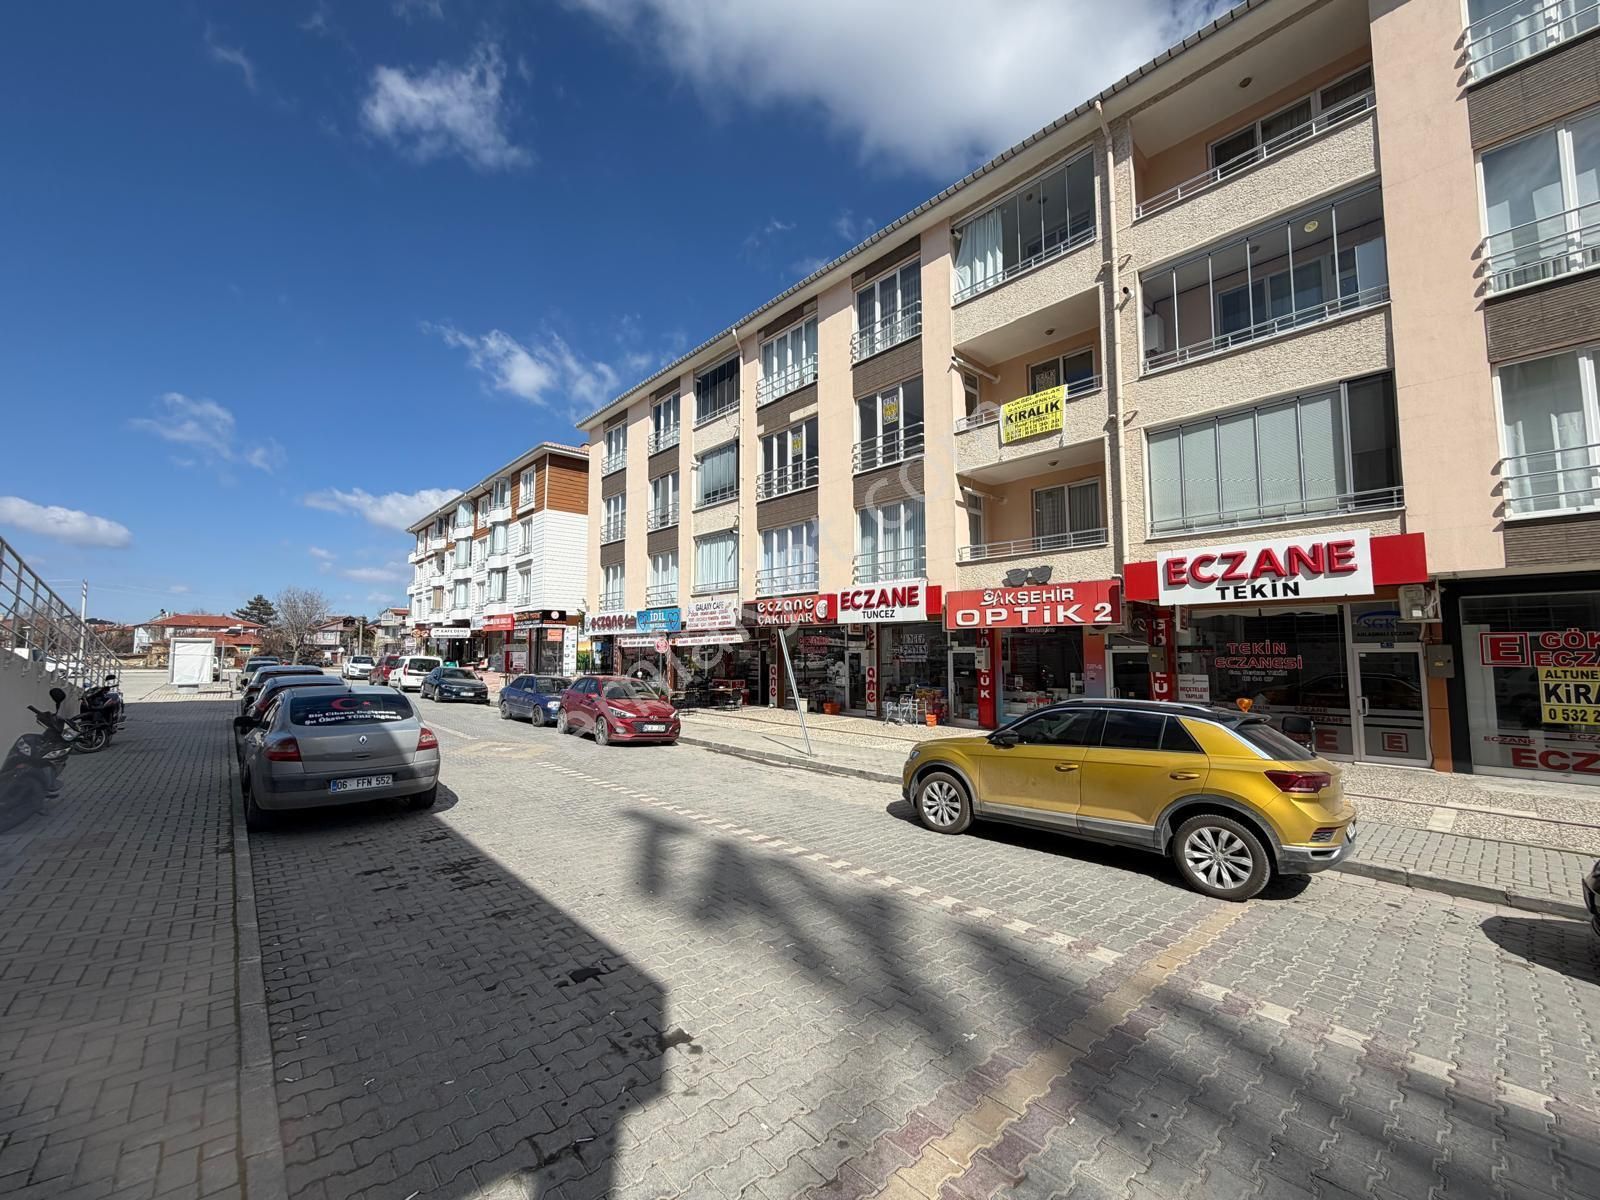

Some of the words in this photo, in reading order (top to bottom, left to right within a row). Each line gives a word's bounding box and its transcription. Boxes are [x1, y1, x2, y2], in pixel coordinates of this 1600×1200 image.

[1165, 539, 1358, 587] ECZANE
[757, 597, 814, 613] eczane
[840, 585, 919, 611] ECZANE
[757, 612, 813, 627] ÇAKILLAR
[862, 608, 895, 619] TUNCEZ
[1094, 602, 1112, 623] 2
[1489, 636, 1523, 663] E
[1549, 708, 1557, 721] 0
[1562, 709, 1588, 722] 532
[1484, 735, 1536, 745] ECZANE
[337, 780, 348, 790] 06
[356, 778, 372, 788] FFN
[375, 776, 391, 786] 552
